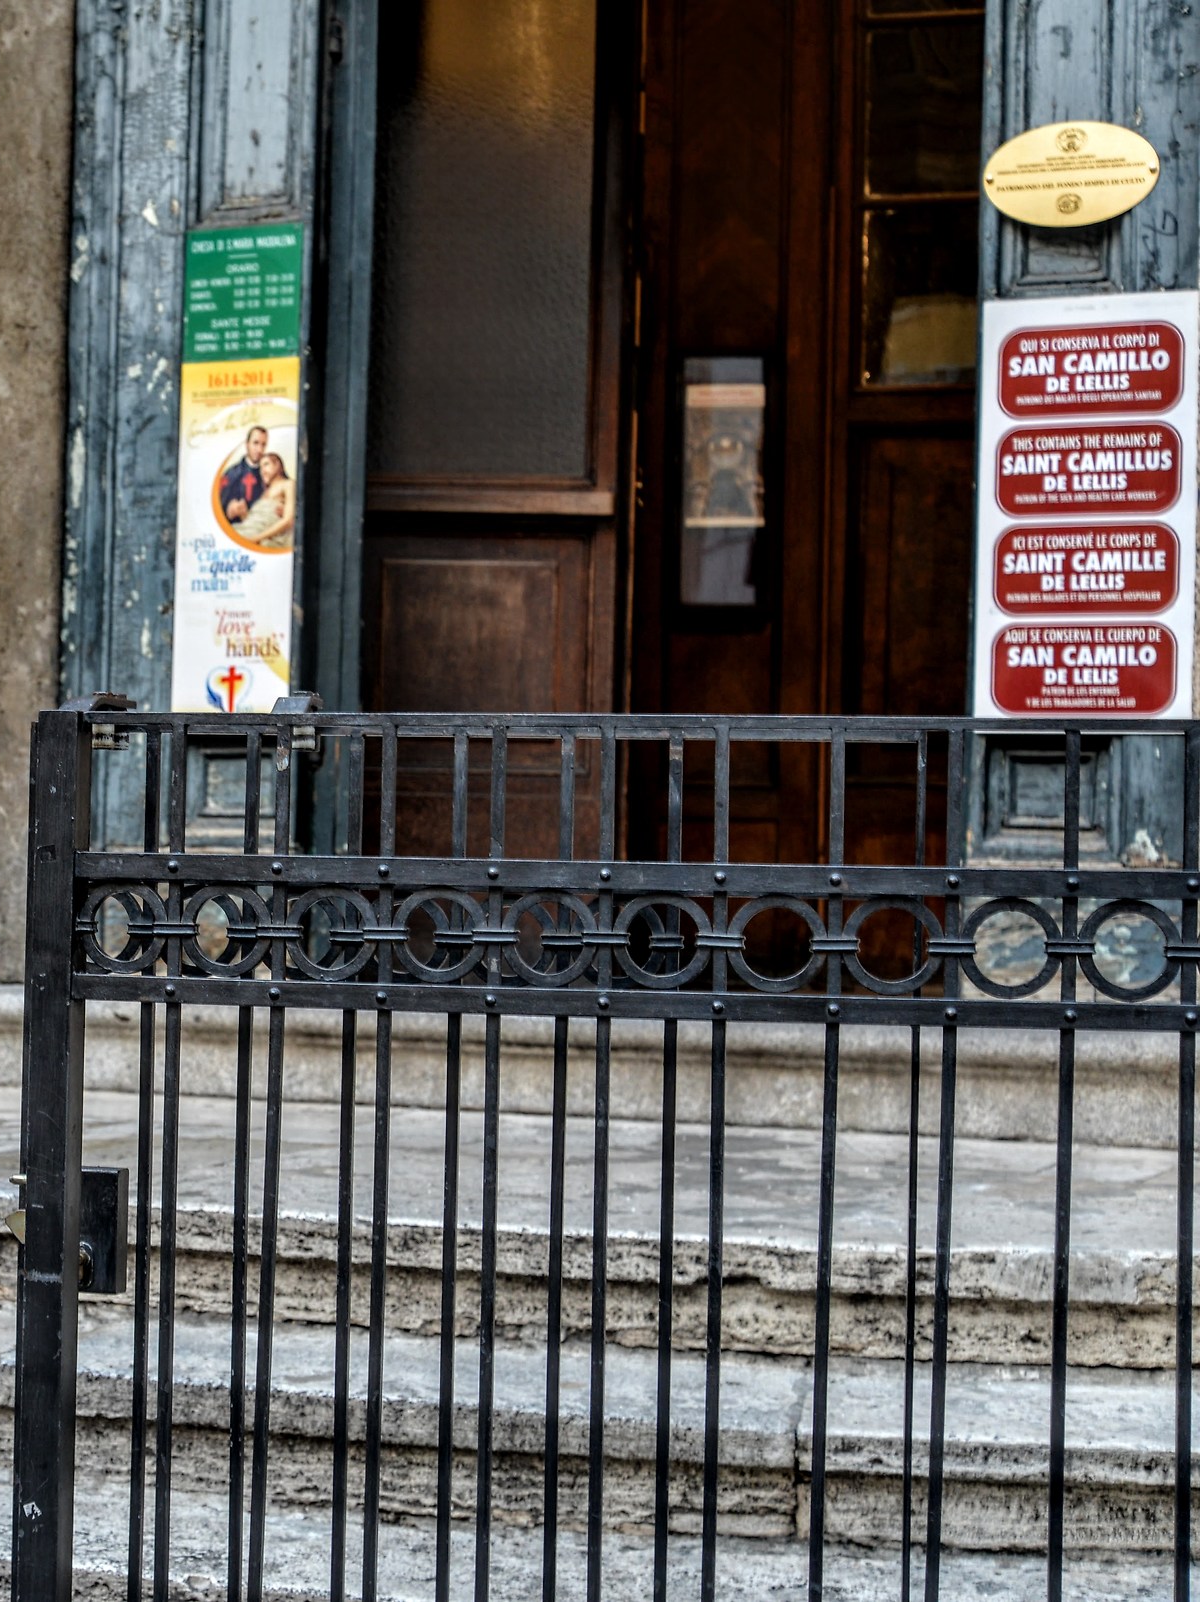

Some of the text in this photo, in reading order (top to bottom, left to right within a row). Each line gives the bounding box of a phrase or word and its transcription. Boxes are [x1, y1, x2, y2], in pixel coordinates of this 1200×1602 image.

[225, 262, 260, 274] ORARIO
[211, 315, 271, 329] SANTE MESSE
[1020, 332, 1160, 353] QUI SI CONSERVA IL CORPO DI
[1008, 349, 1171, 378] SAN CAMILLO
[208, 369, 273, 389] 1614-2014
[1046, 373, 1131, 394] DE LELLIS
[1012, 432, 1163, 452] THIS CONTAINS THE REMAINS OF
[1002, 448, 1173, 477] SAINT CAMILLUS
[1043, 472, 1128, 492] DE LELLIS
[1127, 490, 1157, 502] WORKERS
[1013, 531, 1157, 550] ICI EST CONSERVÉ LE CORPS DE
[209, 555, 257, 577] quelle
[1003, 550, 1167, 574] SAINT CAMILLE
[1041, 573, 1125, 592] DE LELLIS
[1088, 591, 1122, 602] PERSONNEL
[1123, 590, 1162, 601] HOSPITALIER
[216, 612, 255, 636] love
[1030, 629, 1041, 643] SE
[1043, 628, 1092, 643] CONSERVA
[1094, 628, 1106, 643] EL
[1108, 628, 1146, 643] CUERPO
[1149, 628, 1162, 643] DE
[1007, 645, 1157, 667] SAN CAMILO
[1043, 667, 1119, 685] DE LELIS
